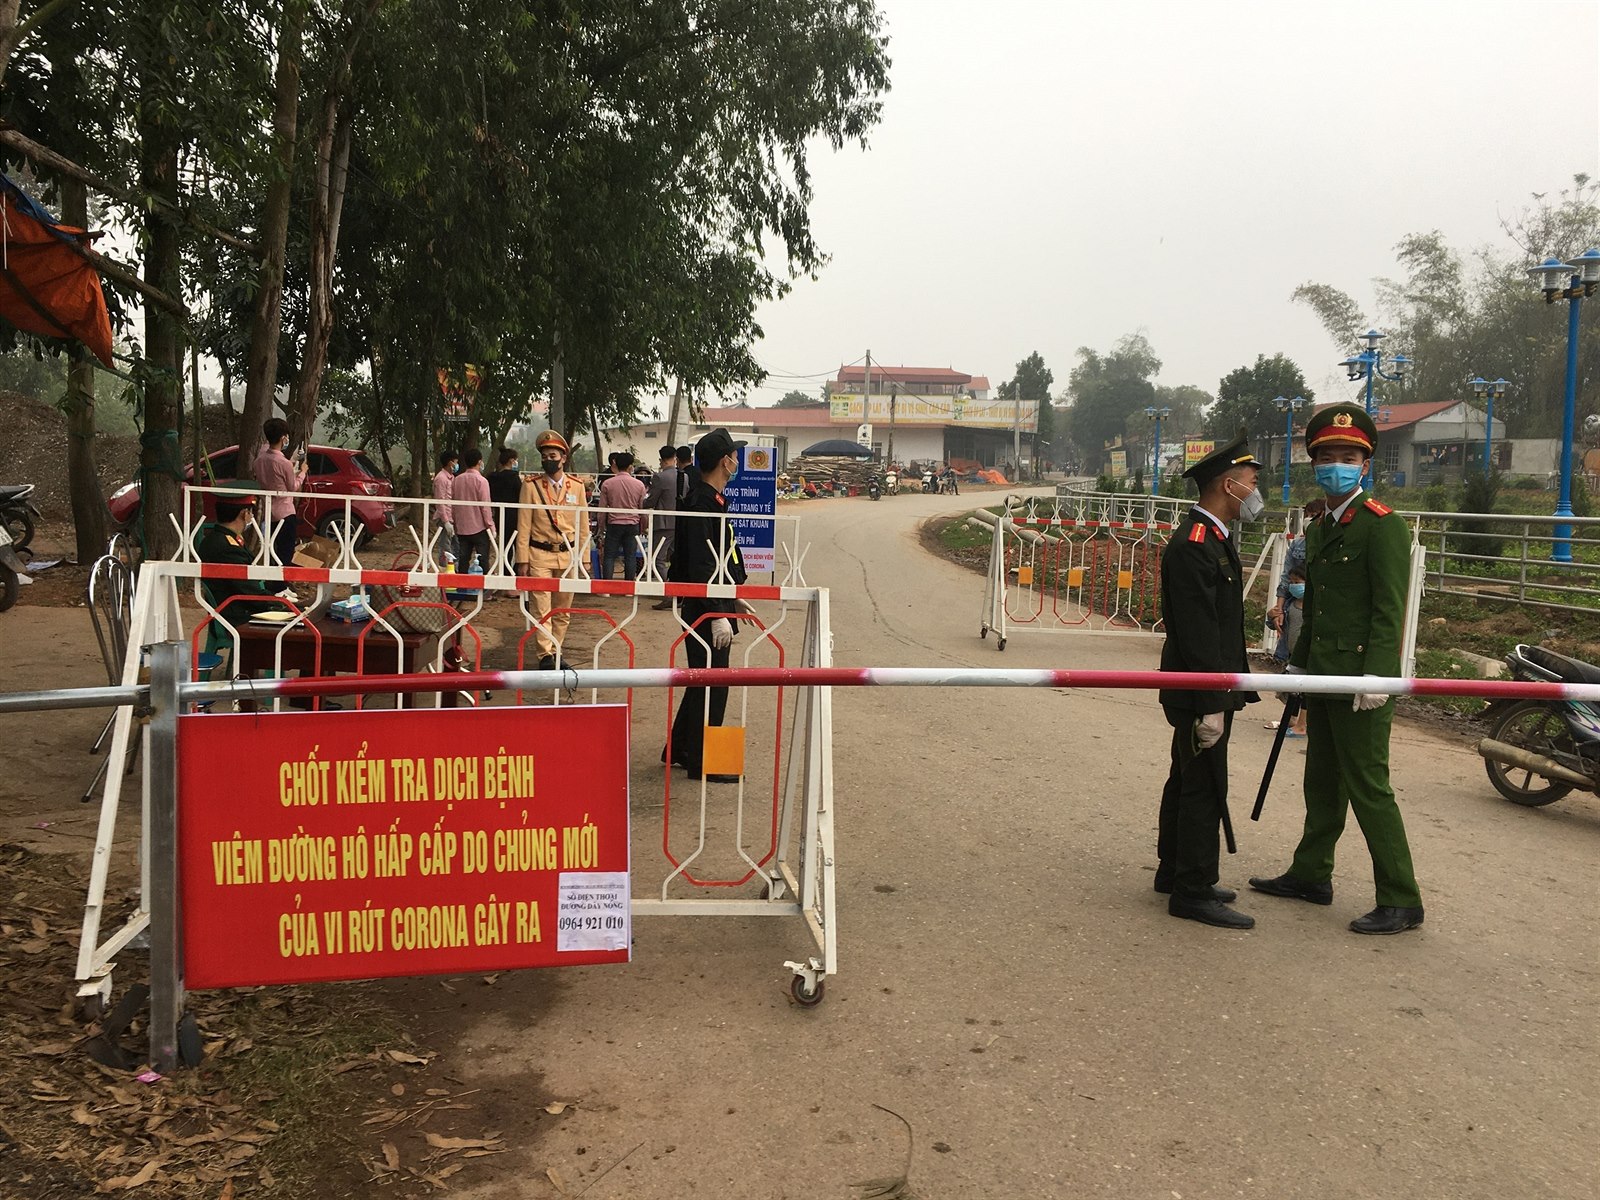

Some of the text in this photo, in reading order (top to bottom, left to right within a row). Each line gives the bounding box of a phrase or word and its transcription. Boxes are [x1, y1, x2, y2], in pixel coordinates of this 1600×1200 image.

[740, 503, 759, 512] TRANG
[759, 503, 764, 512] Y
[279, 740, 535, 811] CHỐT KIỂM TRA DỊCH BỆNH
[211, 809, 599, 886] VIÊM ĐƯỜNG HÔ HẤP CẤP DO CHỦNG MỚI
[278, 893, 542, 958] CỦA VI RÚT CORONA GÂY RA
[559, 916, 624, 930] 0964 921 010
